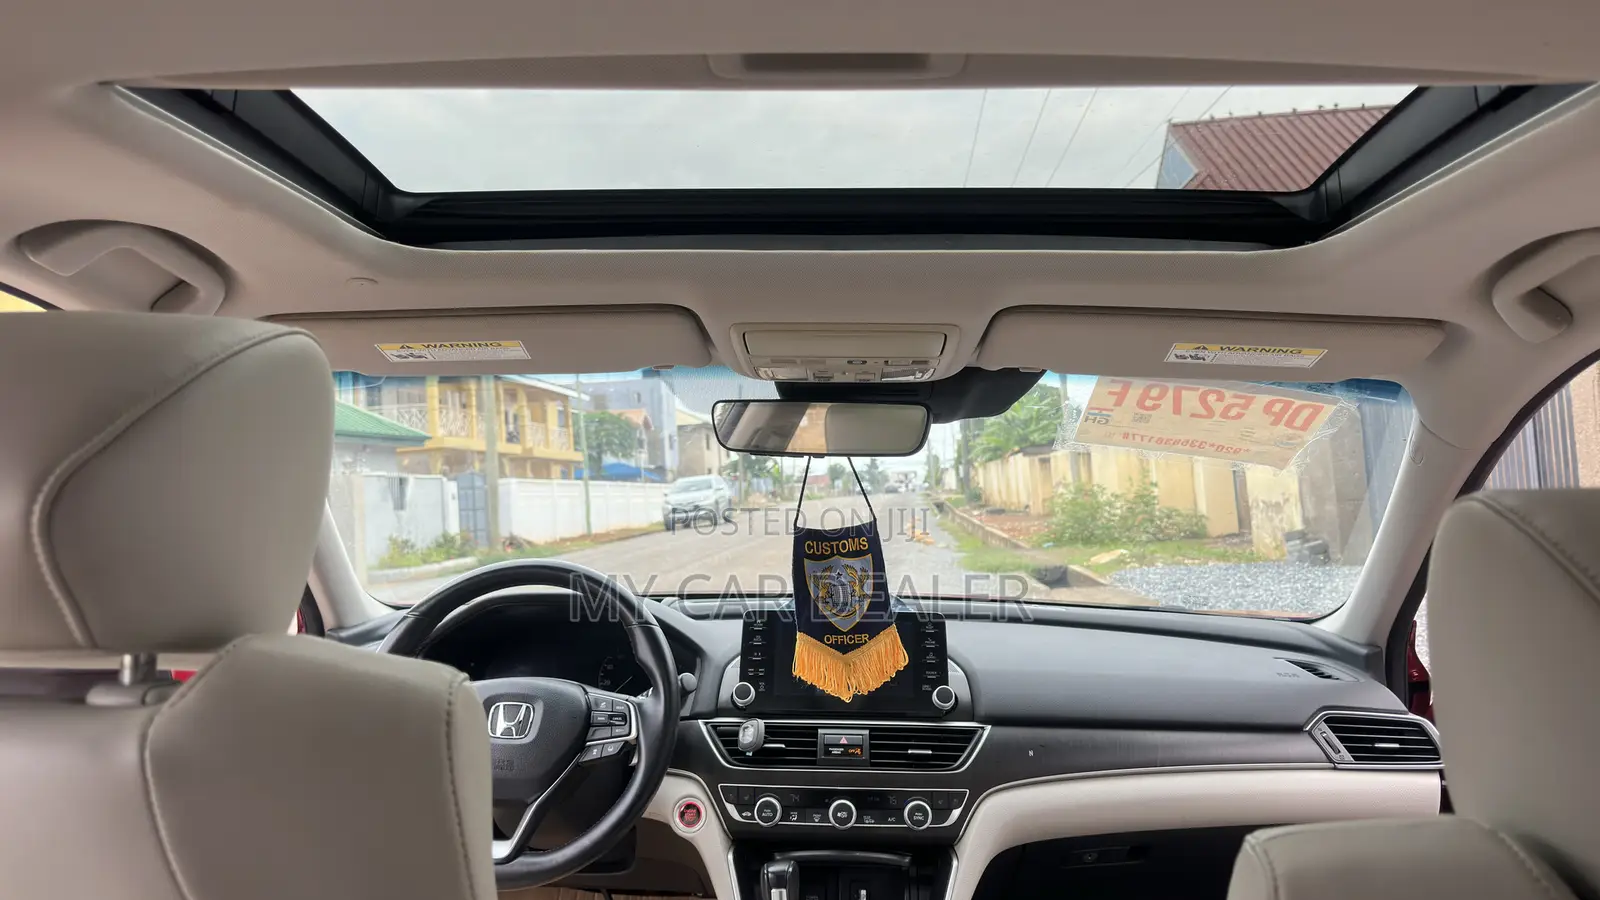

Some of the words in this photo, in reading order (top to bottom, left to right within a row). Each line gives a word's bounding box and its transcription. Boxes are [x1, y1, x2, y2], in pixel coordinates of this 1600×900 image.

[422, 341, 502, 349] WARNING
[1219, 346, 1302, 355] WARNING
[804, 536, 869, 555] CUSTOMS
[824, 633, 869, 645] OFFICER
